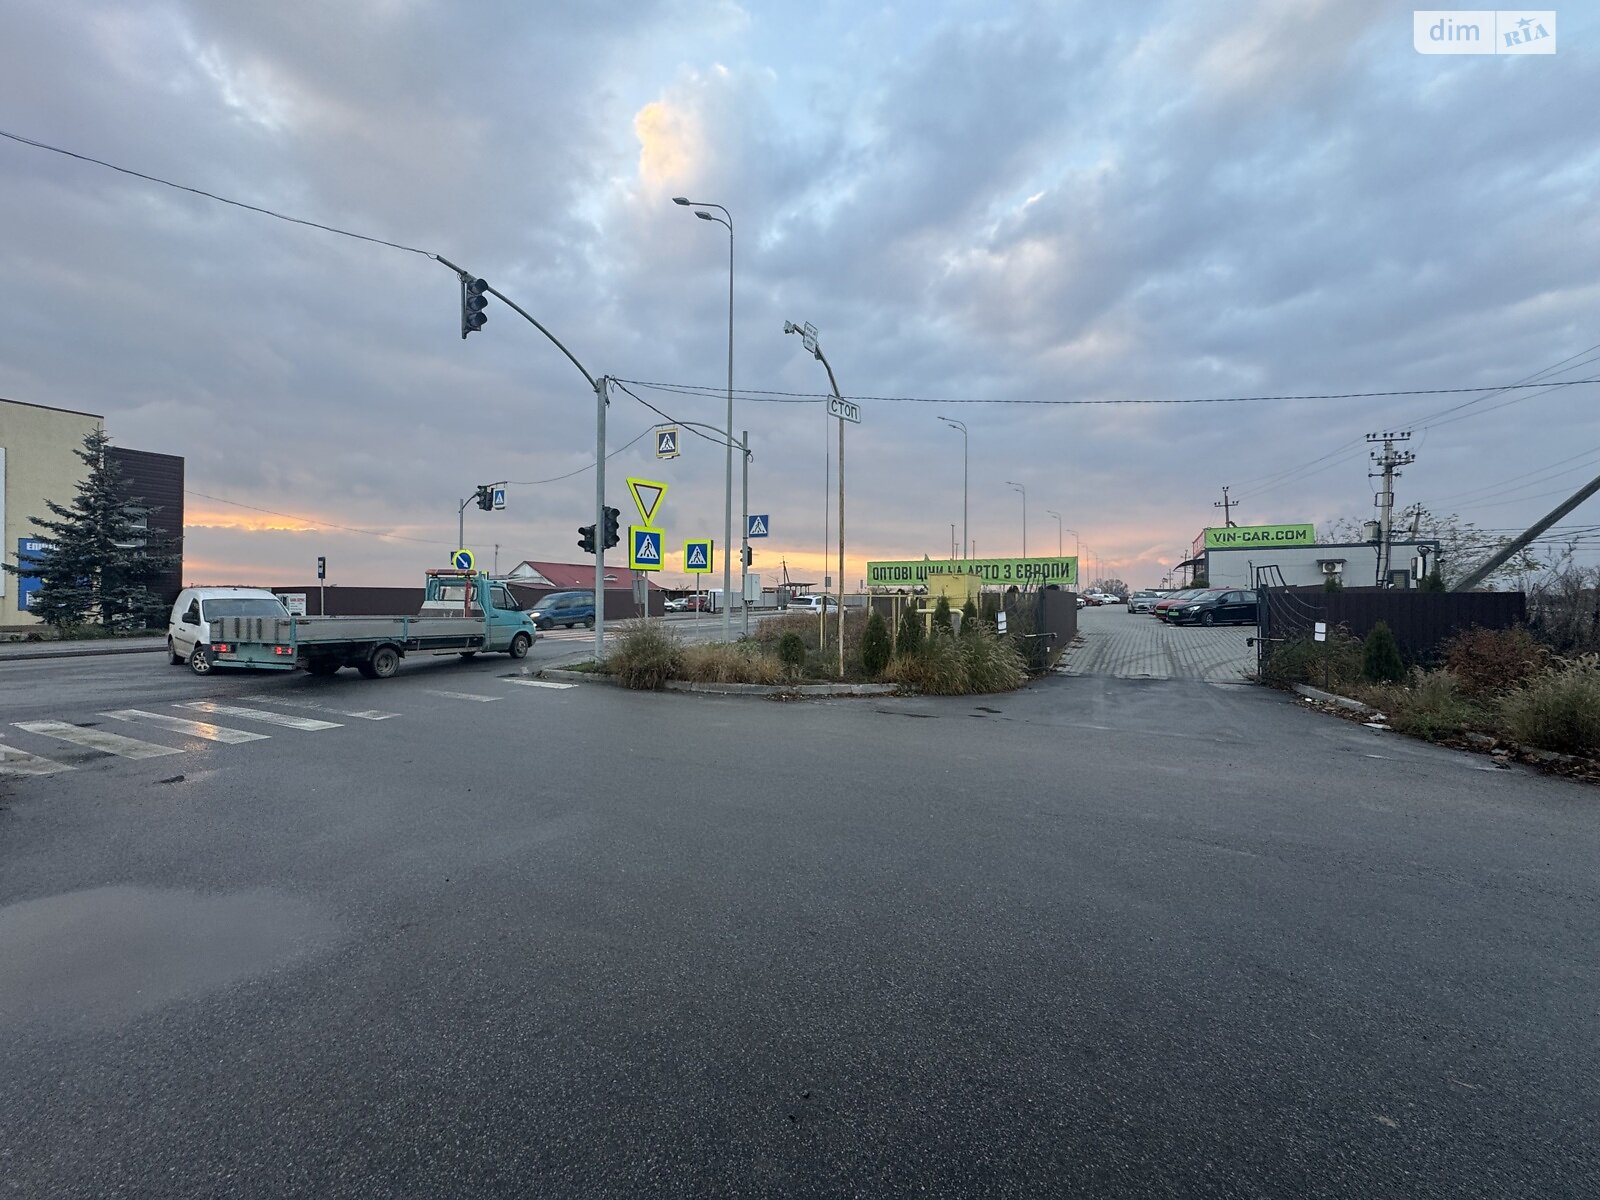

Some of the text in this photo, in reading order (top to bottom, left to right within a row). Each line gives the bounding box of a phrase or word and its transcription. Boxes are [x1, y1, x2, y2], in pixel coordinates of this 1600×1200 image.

[831, 399, 858, 420] СТОП
[1213, 529, 1307, 543] VIN-CAR.COM
[872, 566, 912, 581] ОПТОВІ
[1003, 563, 1012, 580] З
[1016, 562, 1070, 579] ЄВРОПИ
